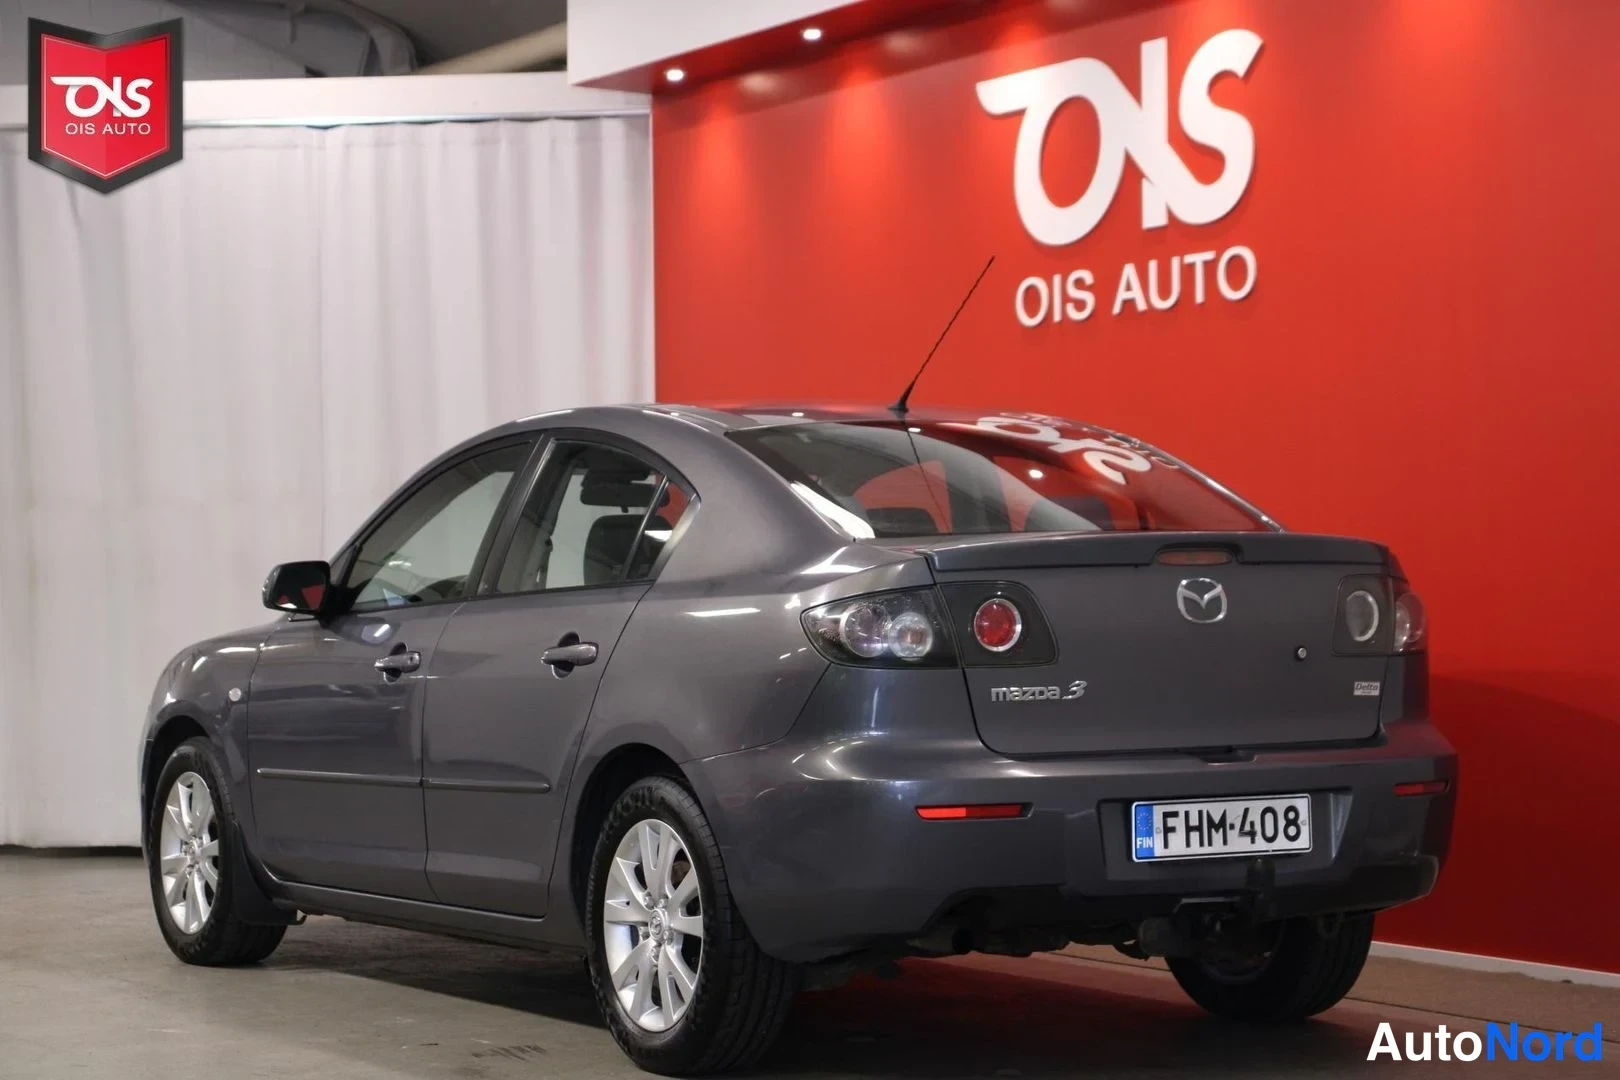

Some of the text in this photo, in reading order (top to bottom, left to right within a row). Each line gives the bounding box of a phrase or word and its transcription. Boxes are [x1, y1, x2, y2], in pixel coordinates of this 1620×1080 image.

[1015, 245, 1257, 327] OIS AUTO
[1061, 680, 1087, 699] 3
[1136, 836, 1153, 849] FIN
[1162, 805, 1301, 849] FHM-408
